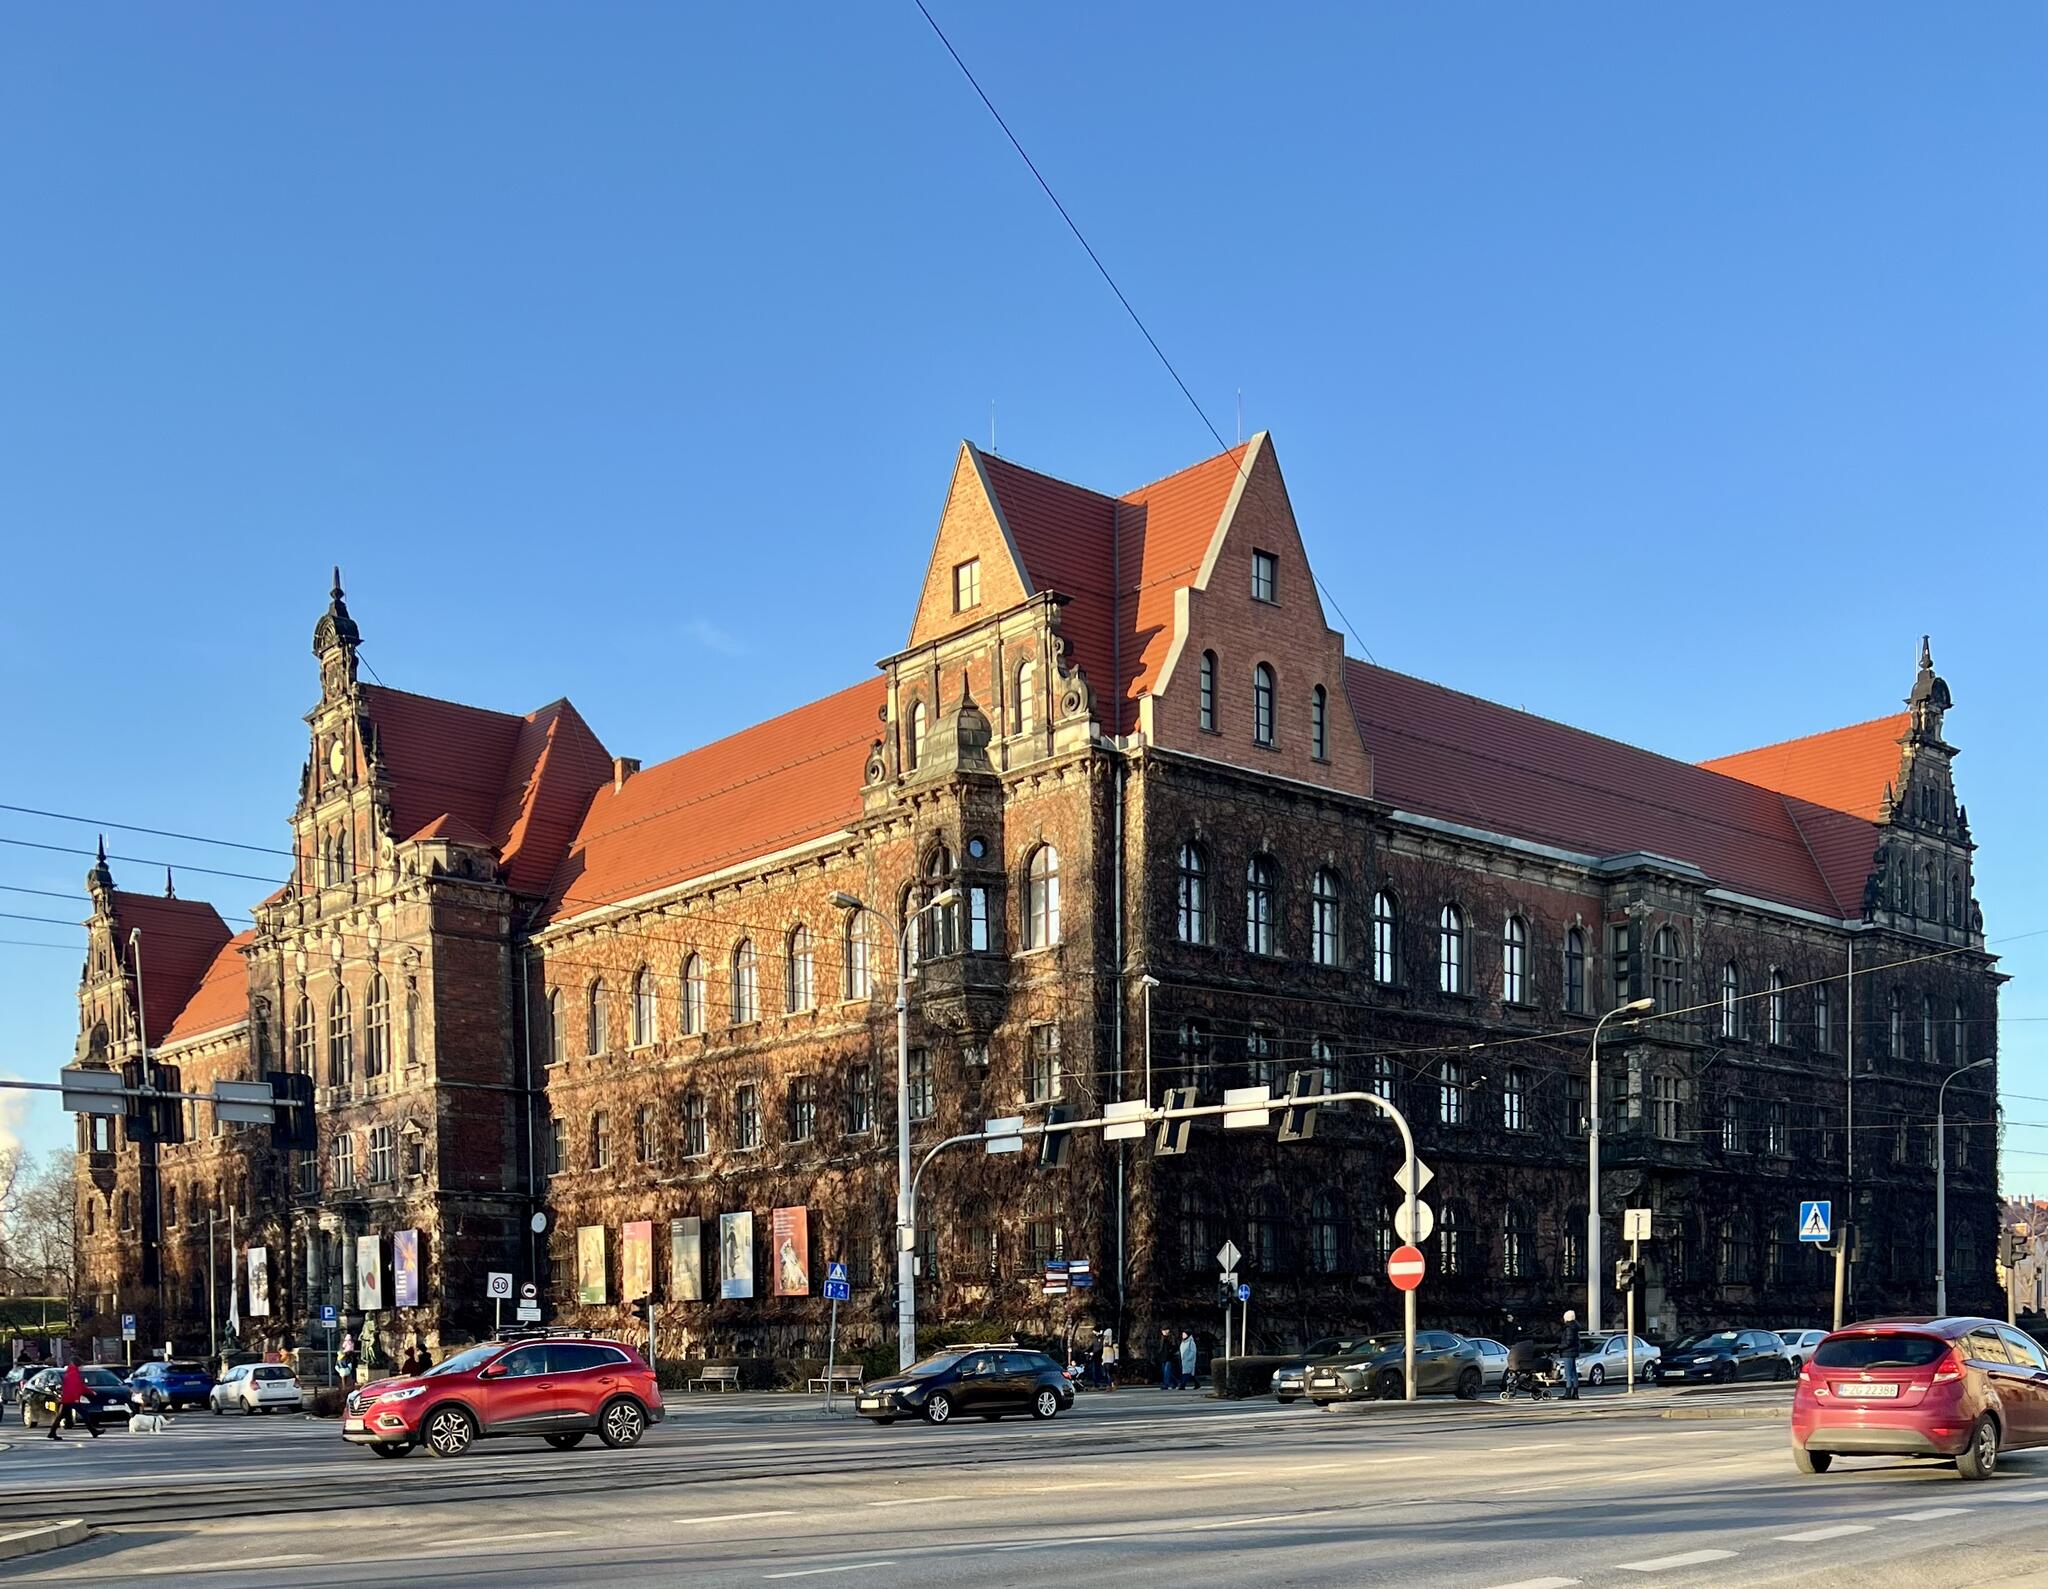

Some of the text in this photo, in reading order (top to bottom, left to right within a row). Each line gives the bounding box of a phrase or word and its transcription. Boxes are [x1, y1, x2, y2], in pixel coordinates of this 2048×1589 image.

[494, 1281, 506, 1290] 30
[324, 1306, 334, 1319] P
[125, 1315, 133, 1325] P
